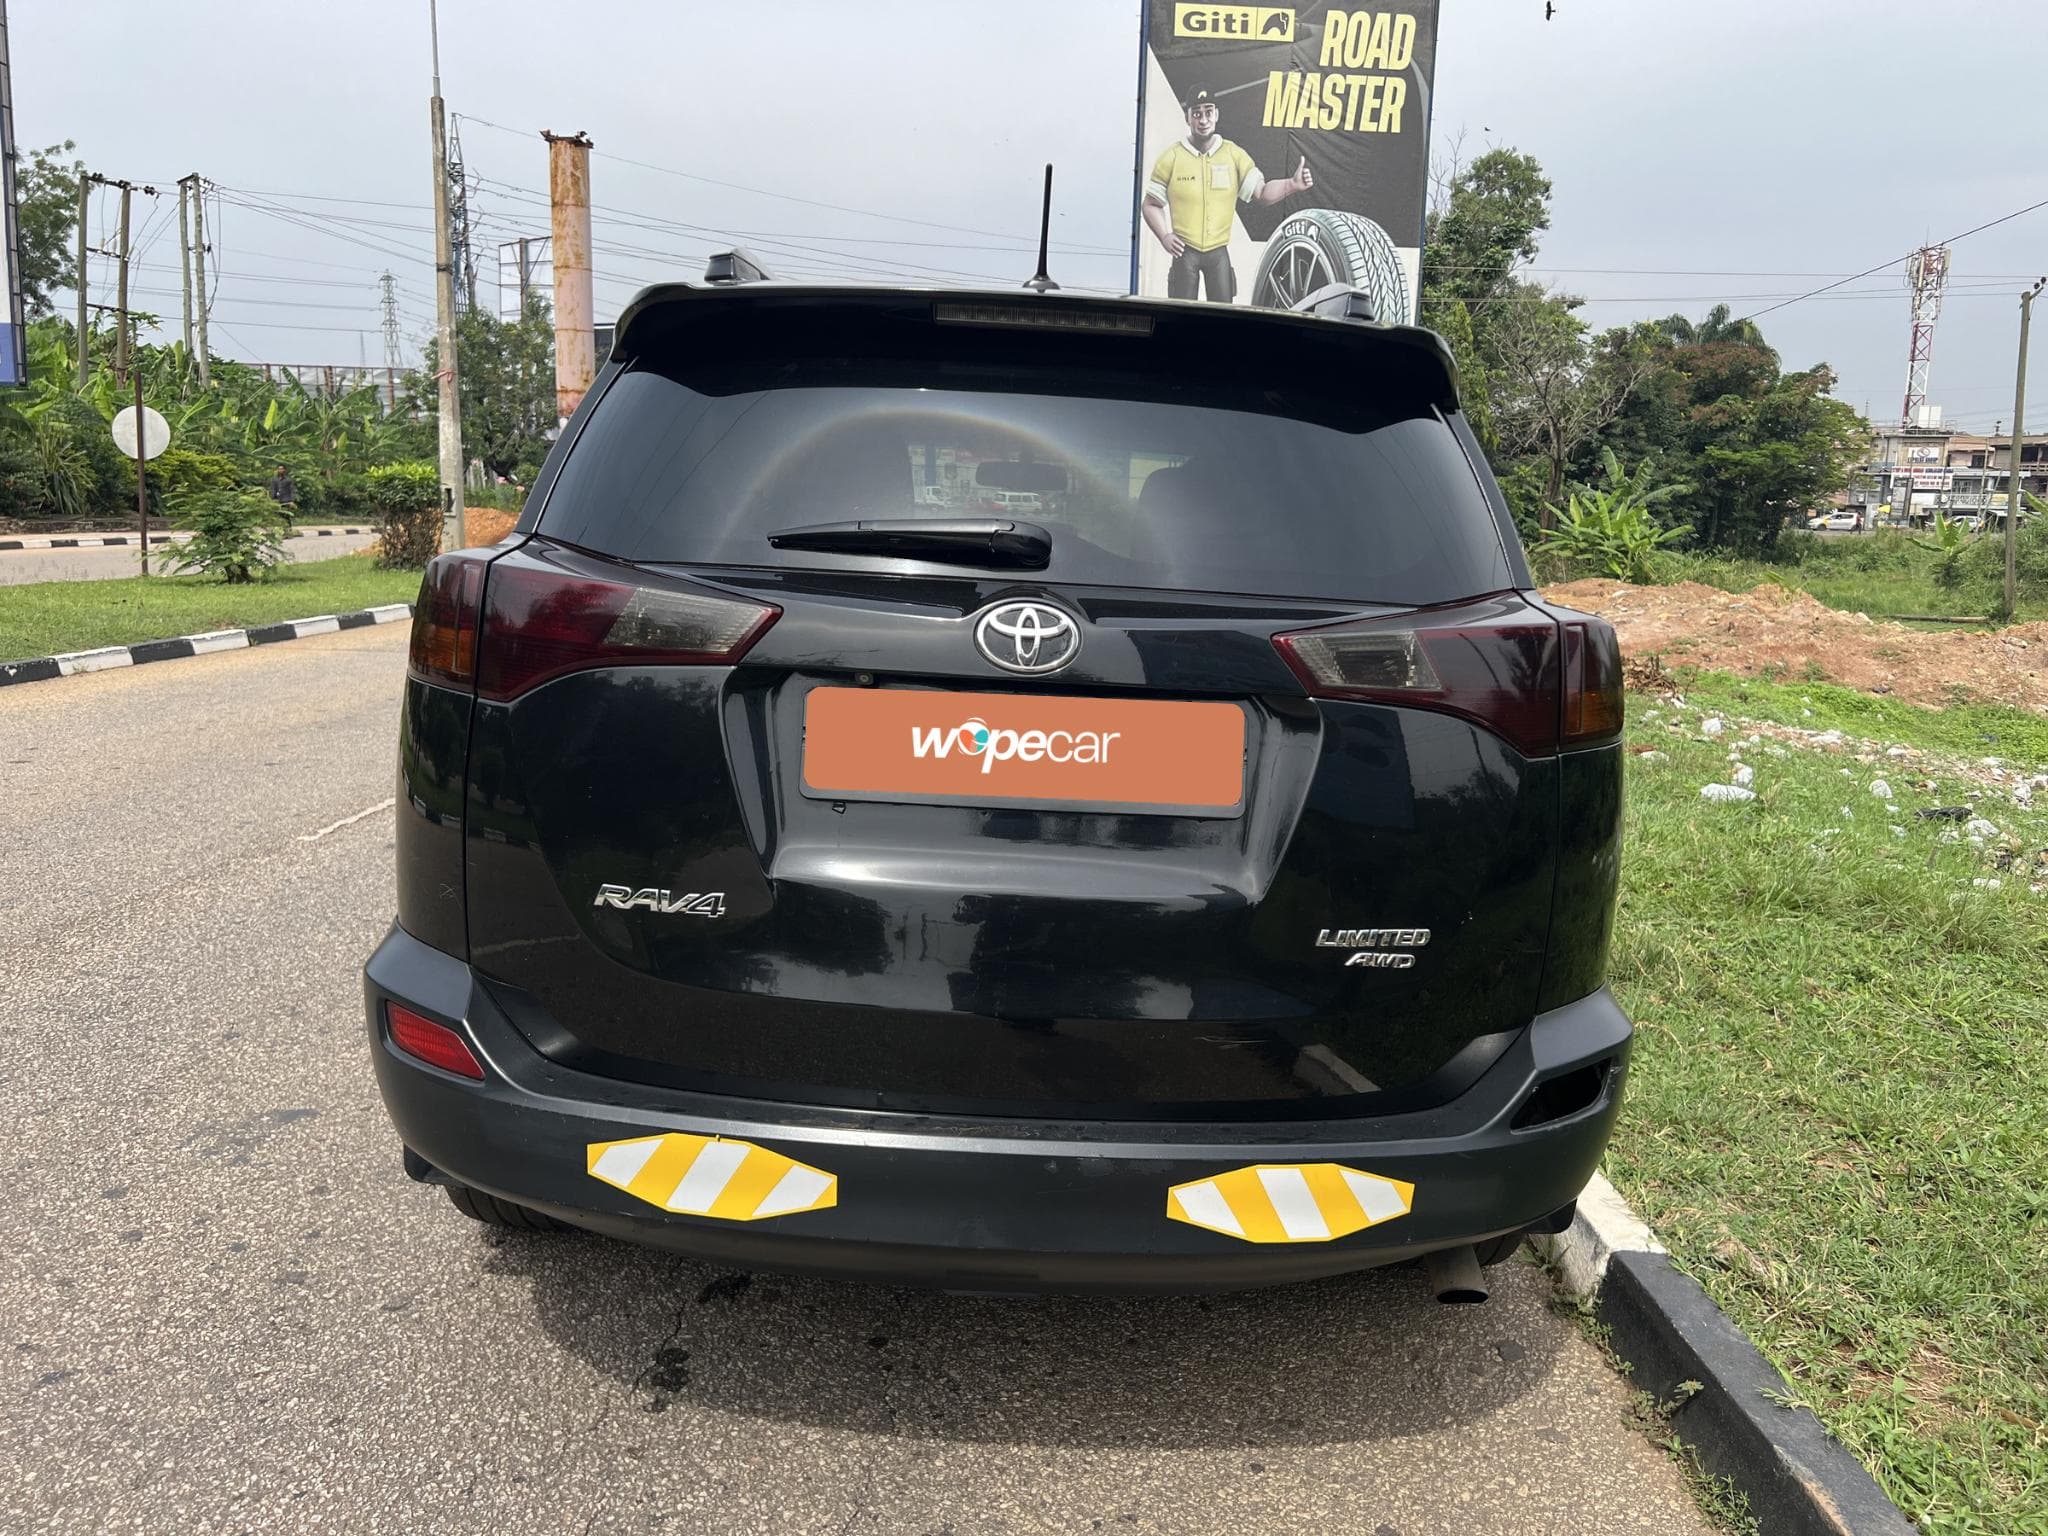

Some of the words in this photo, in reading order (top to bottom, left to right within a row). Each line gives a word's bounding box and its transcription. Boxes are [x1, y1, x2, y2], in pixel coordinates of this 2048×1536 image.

[1182, 10, 1249, 34] Giti
[1319, 10, 1416, 70] ROAD
[1262, 71, 1407, 133] MASTER
[594, 883, 726, 918] RAV4
[1315, 928, 1431, 947] LIMITED
[1344, 952, 1416, 969] AWD
